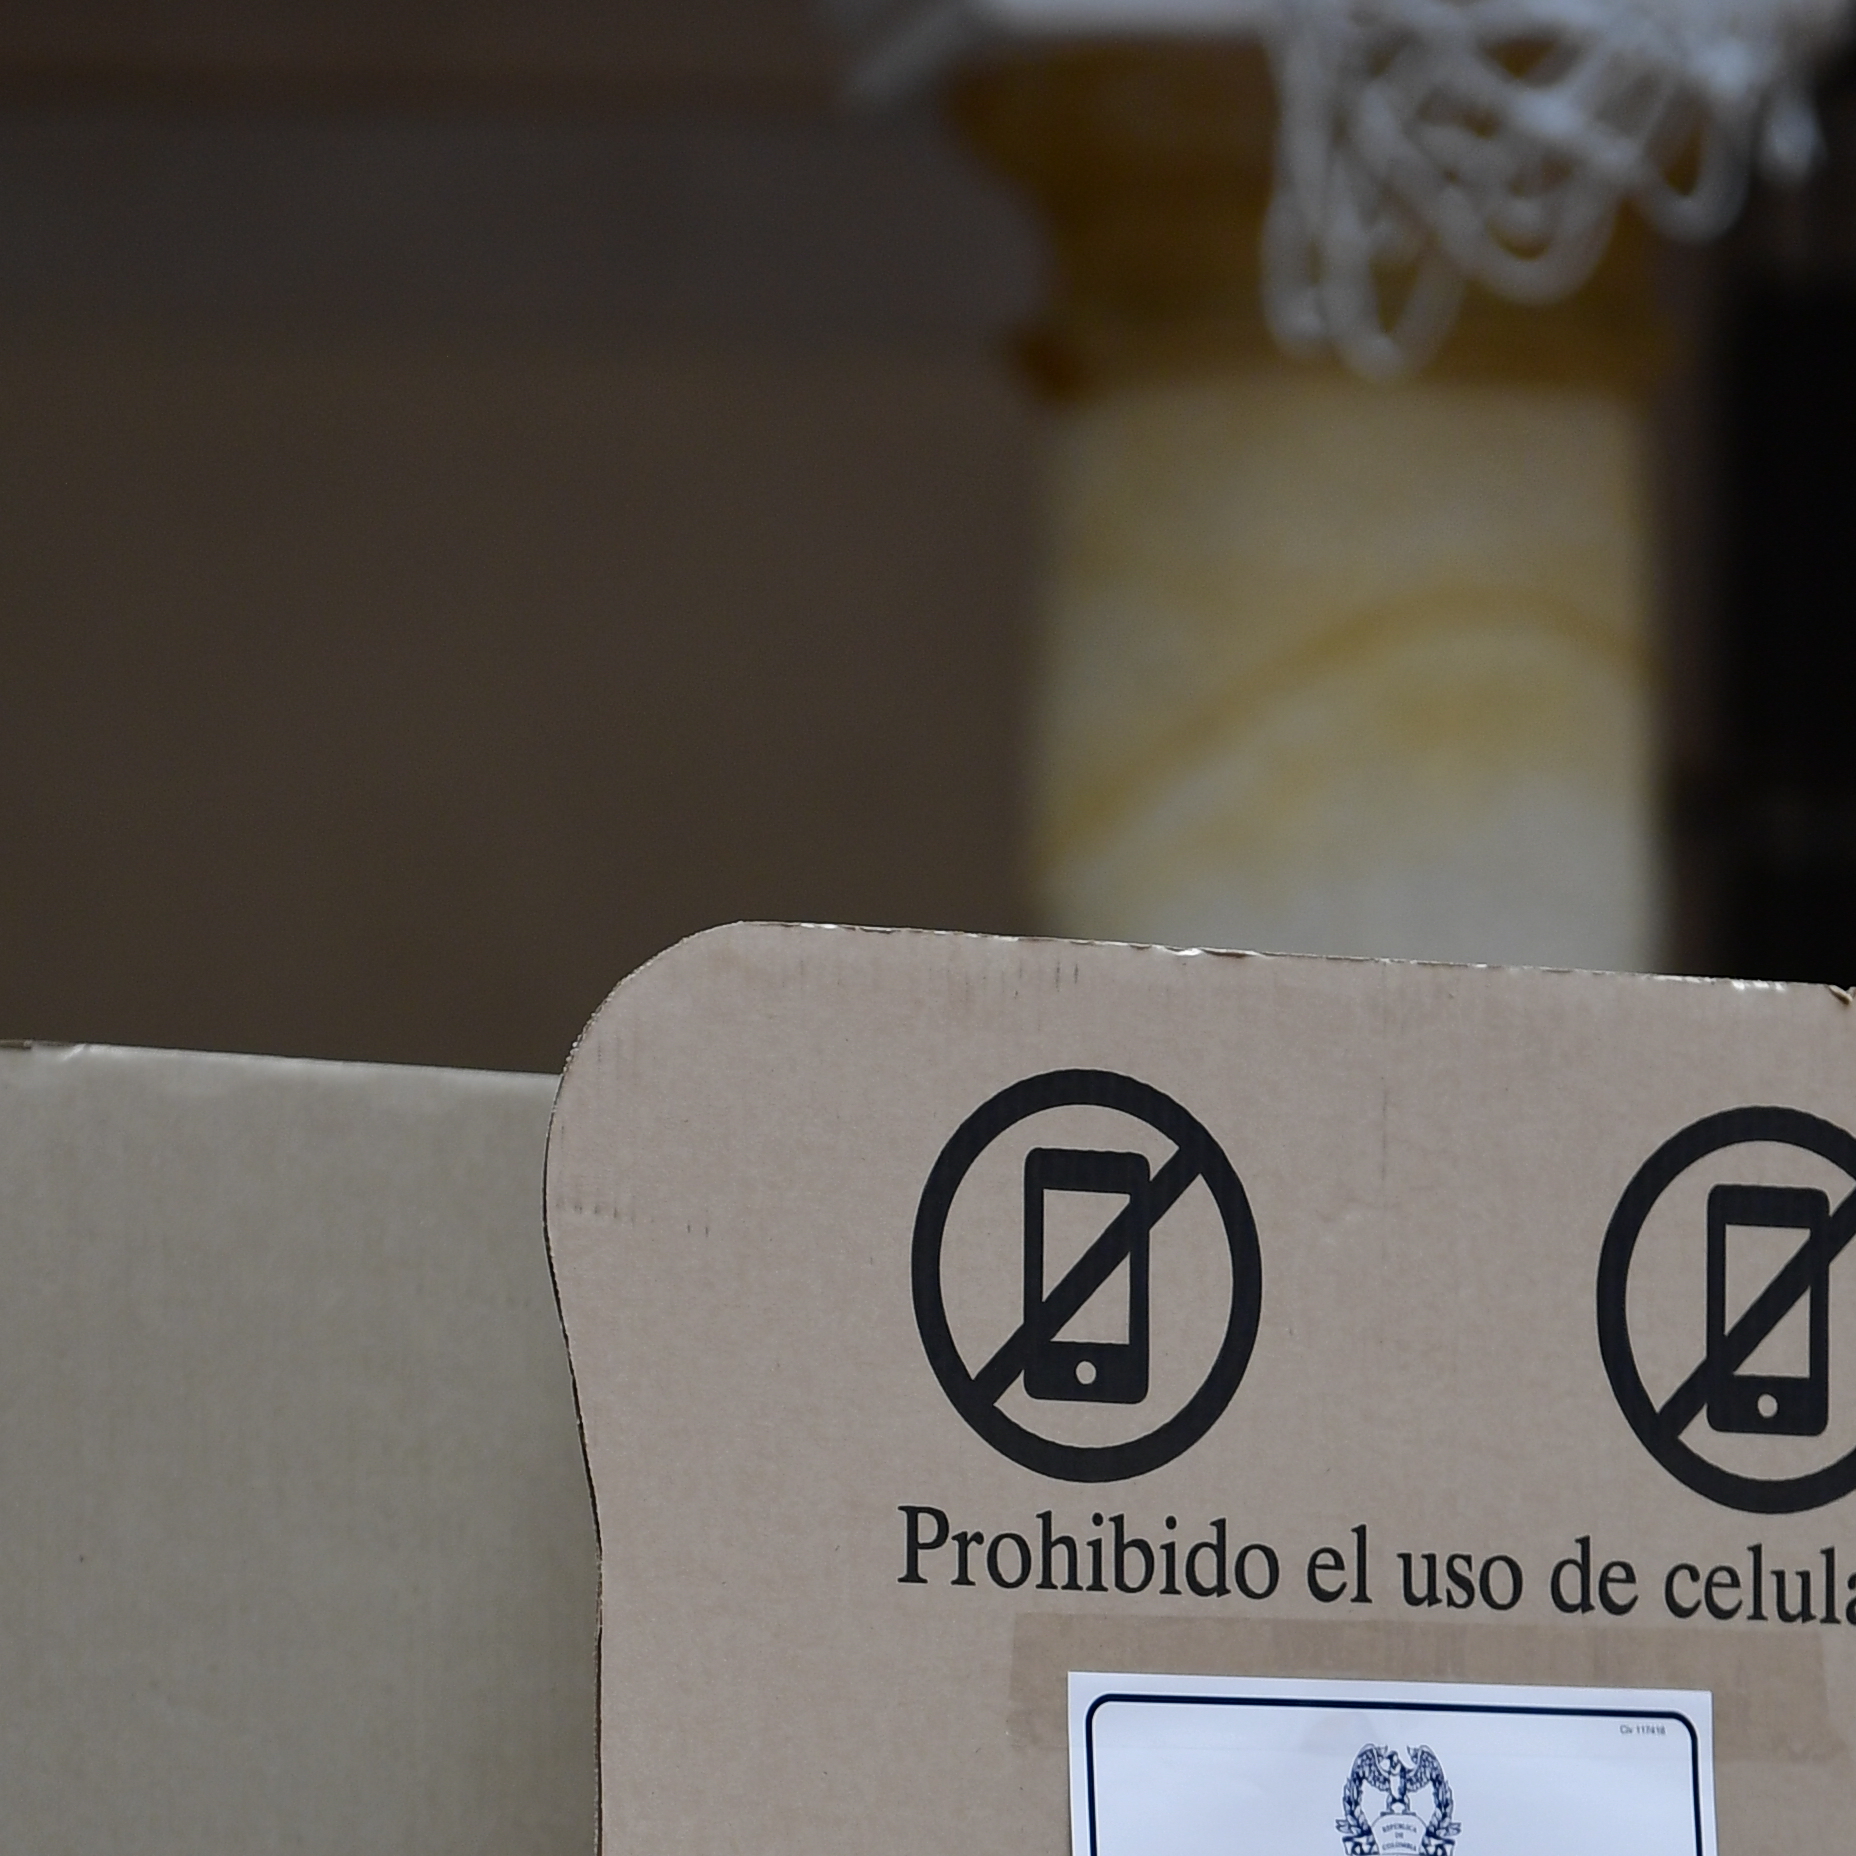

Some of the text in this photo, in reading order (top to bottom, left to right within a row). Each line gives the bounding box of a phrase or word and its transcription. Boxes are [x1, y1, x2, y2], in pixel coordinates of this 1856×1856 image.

[897, 1505, 1280, 1600] Prohibido
[1307, 1524, 1373, 1603] el
[1397, 1551, 1524, 1611] uso
[1550, 1535, 1639, 1616] de
